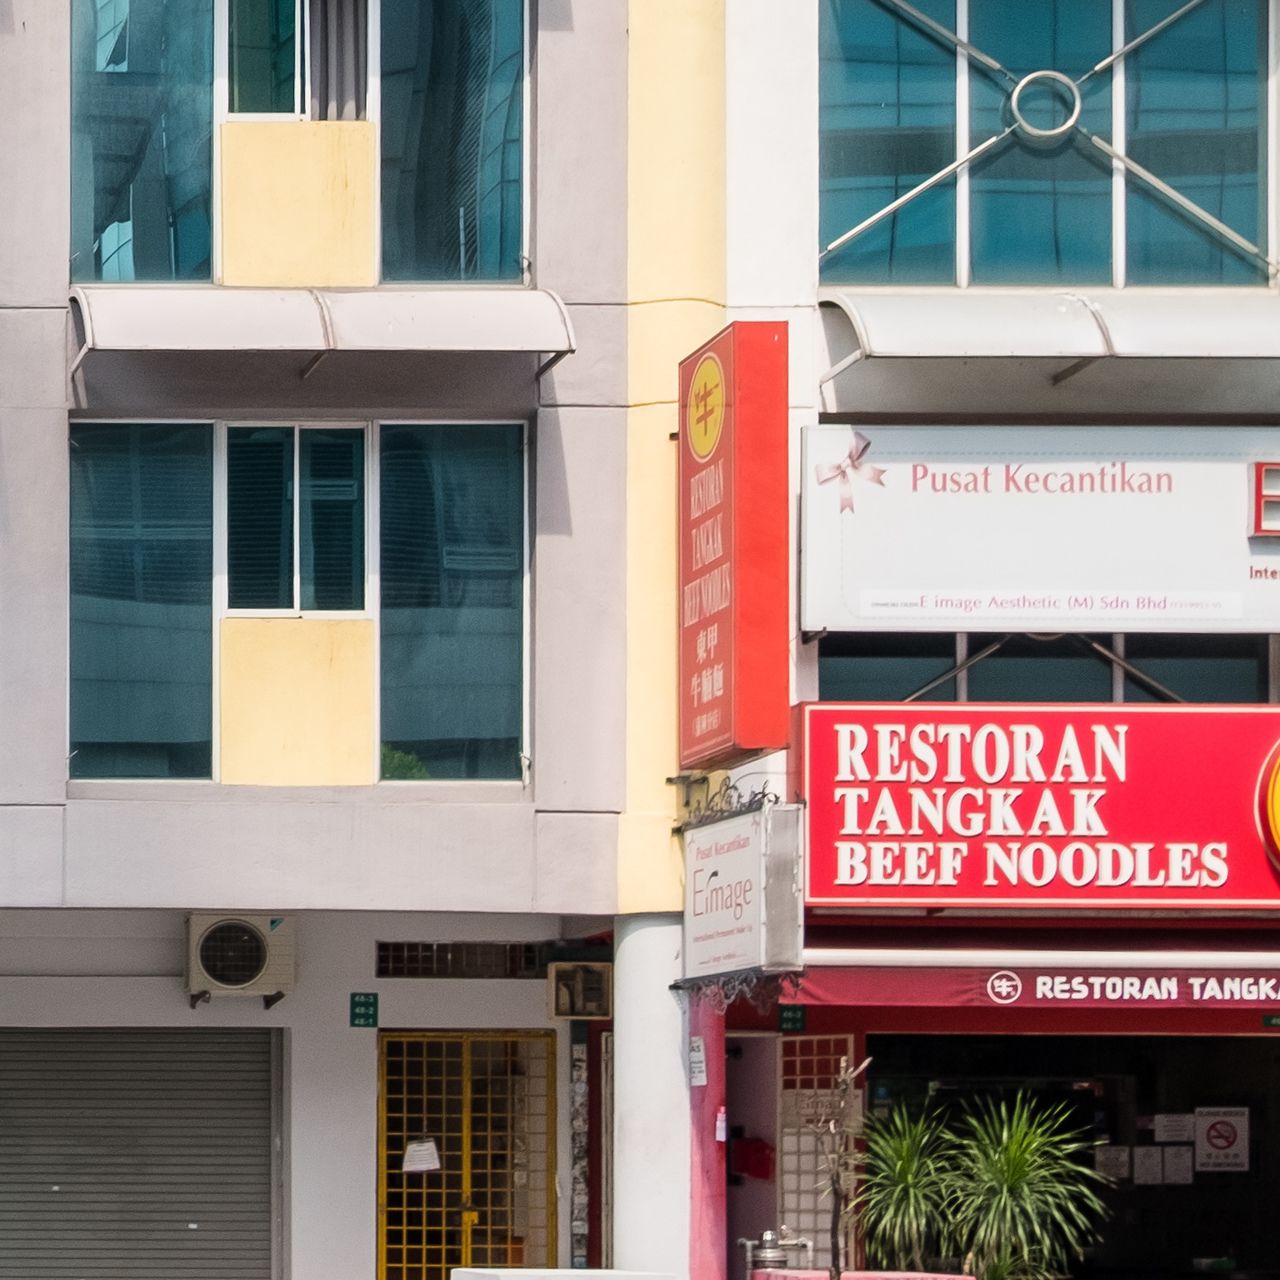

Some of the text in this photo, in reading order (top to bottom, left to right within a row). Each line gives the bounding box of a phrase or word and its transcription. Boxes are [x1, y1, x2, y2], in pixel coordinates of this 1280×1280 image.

[911, 461, 1174, 494] Pusat Kecantikan
[934, 595, 983, 613] image
[987, 595, 1060, 610] Aesthetic
[1100, 596, 1130, 610] Sdn
[1136, 596, 1168, 610] Bhd
[833, 723, 1129, 784] RESTORAN
[834, 787, 1109, 837] TANGKAK
[834, 840, 1228, 888] BEEF NOODLES
[1035, 975, 1280, 1000] RESTORAN TANGK
